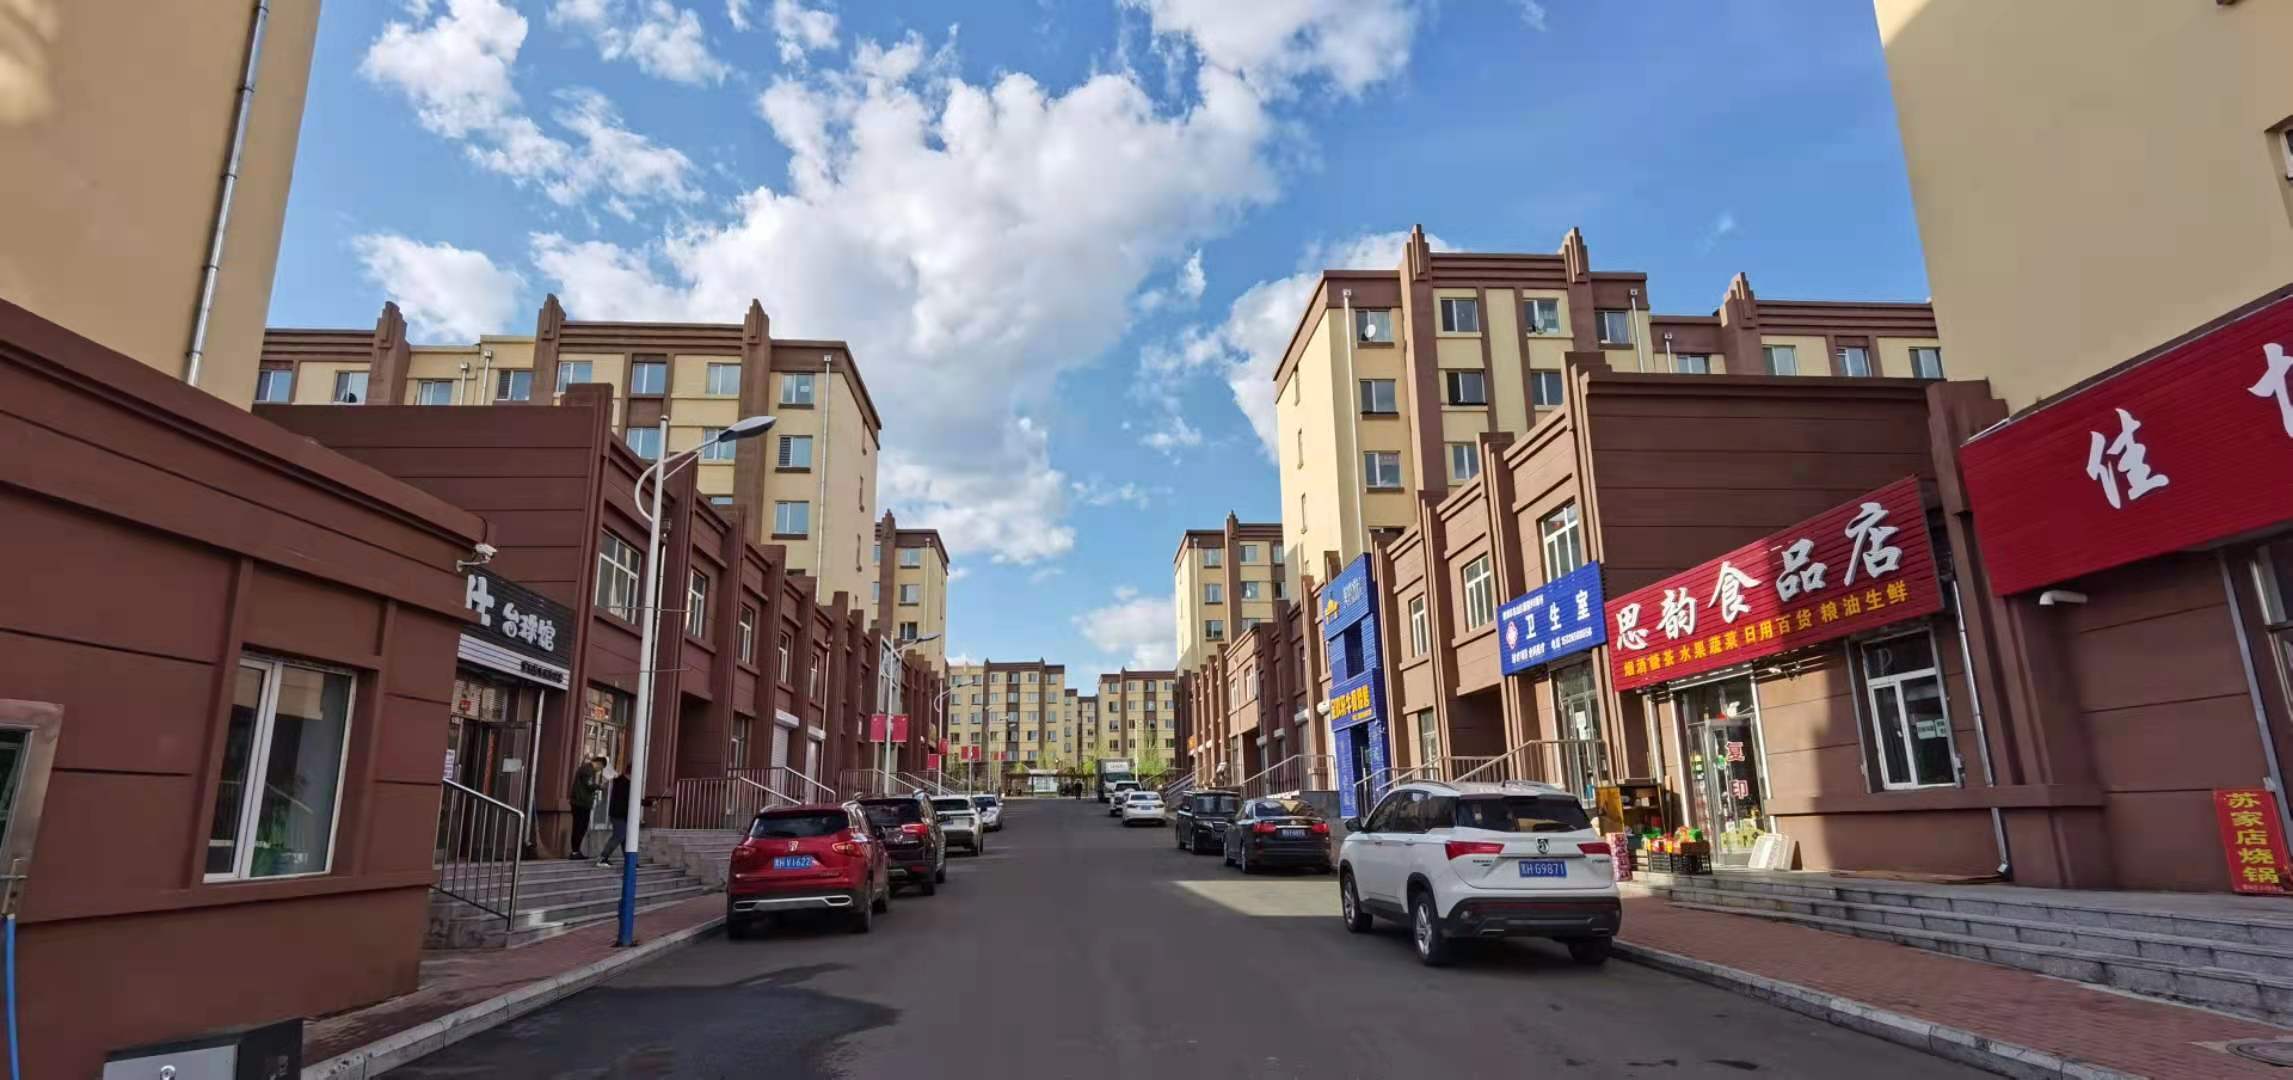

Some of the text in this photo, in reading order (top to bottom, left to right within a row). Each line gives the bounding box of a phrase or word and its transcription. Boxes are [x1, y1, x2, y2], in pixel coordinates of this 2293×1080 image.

[1524, 589, 1591, 640] 卫生室
[1616, 502, 1903, 651] 思韵食品店
[1679, 629, 1739, 662] 水果蔬菜
[1744, 608, 1813, 641] 日用百货
[1820, 580, 1909, 624] 粮油生鲜
[1726, 741, 1749, 800] 复印
[2225, 792, 2281, 884] 苏家店烧锅
